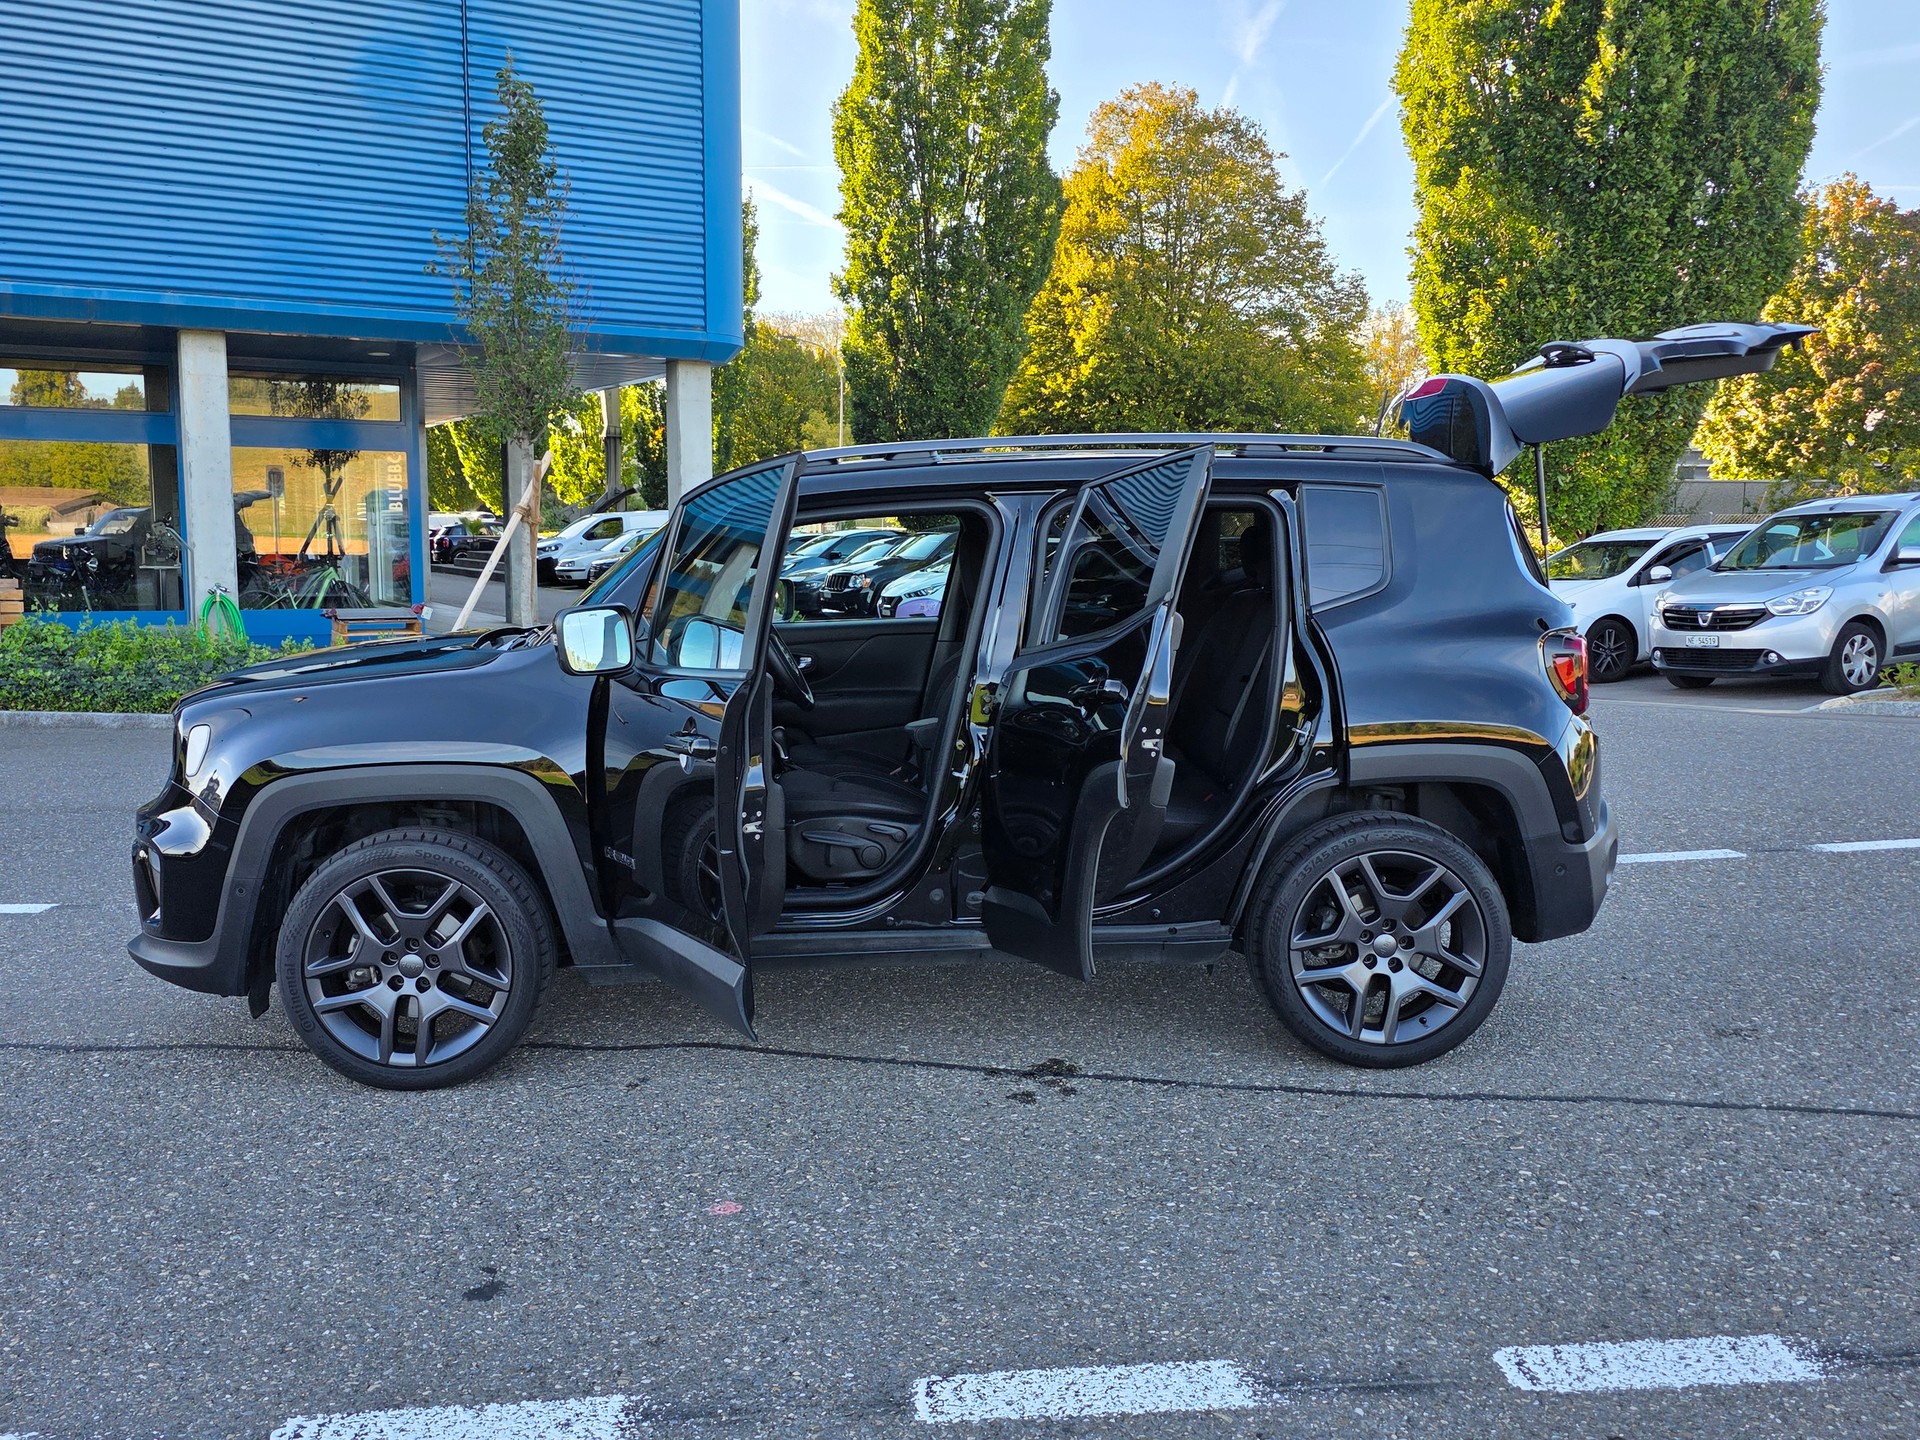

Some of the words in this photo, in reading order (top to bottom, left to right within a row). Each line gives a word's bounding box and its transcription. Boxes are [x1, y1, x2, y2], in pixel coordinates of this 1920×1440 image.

[1687, 637, 1695, 645] NE
[1698, 637, 1716, 645] 54519
[414, 849, 501, 894] SportContact
[1479, 885, 1505, 954] Continental
[287, 962, 315, 1033] Continental
